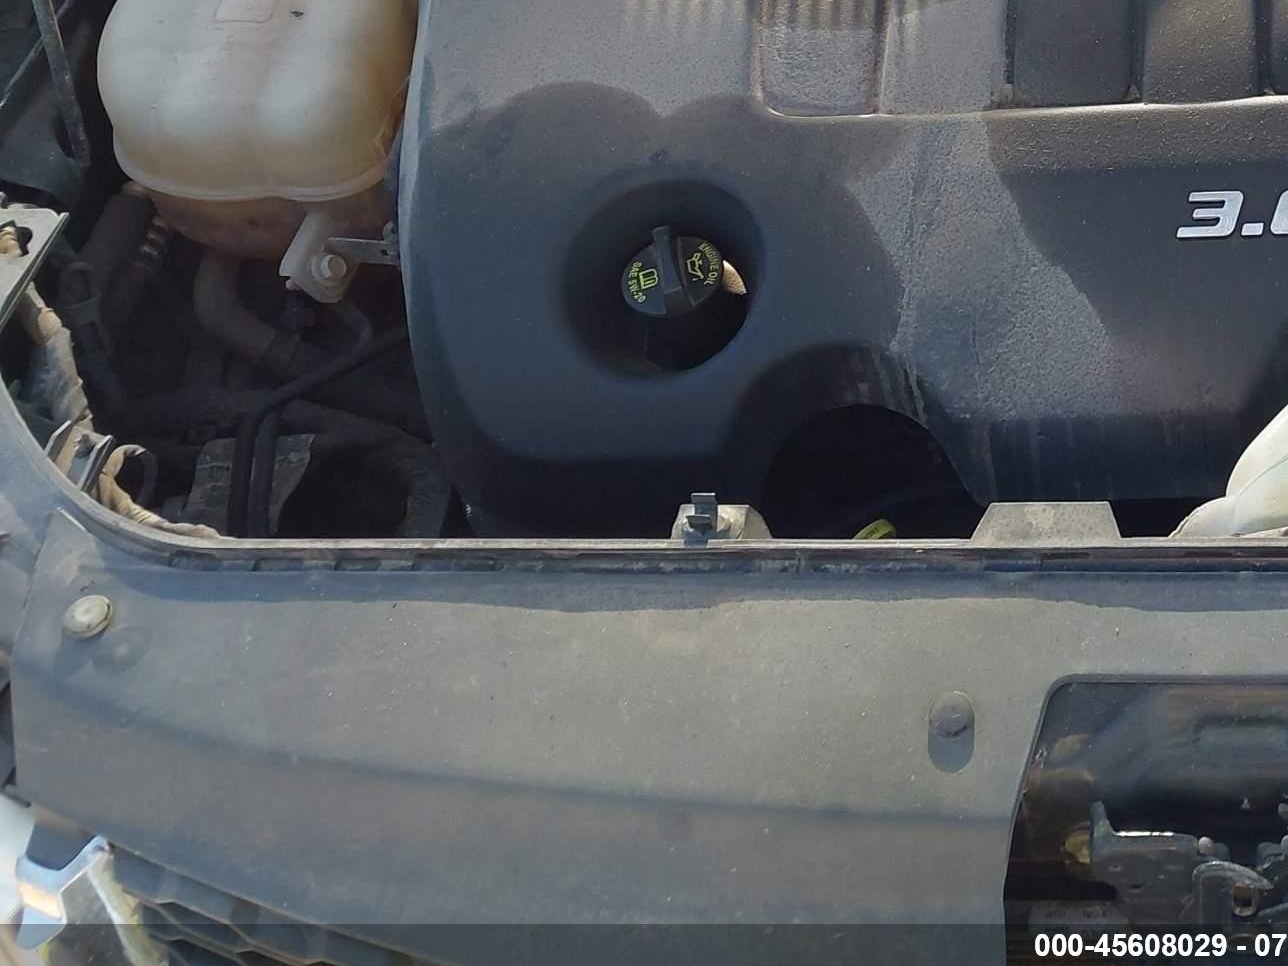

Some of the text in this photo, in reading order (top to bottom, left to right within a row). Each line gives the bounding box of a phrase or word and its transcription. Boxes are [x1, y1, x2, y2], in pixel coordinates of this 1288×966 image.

[627, 260, 647, 303] SAE 5W-20
[698, 242, 720, 286] ENGINE OIL
